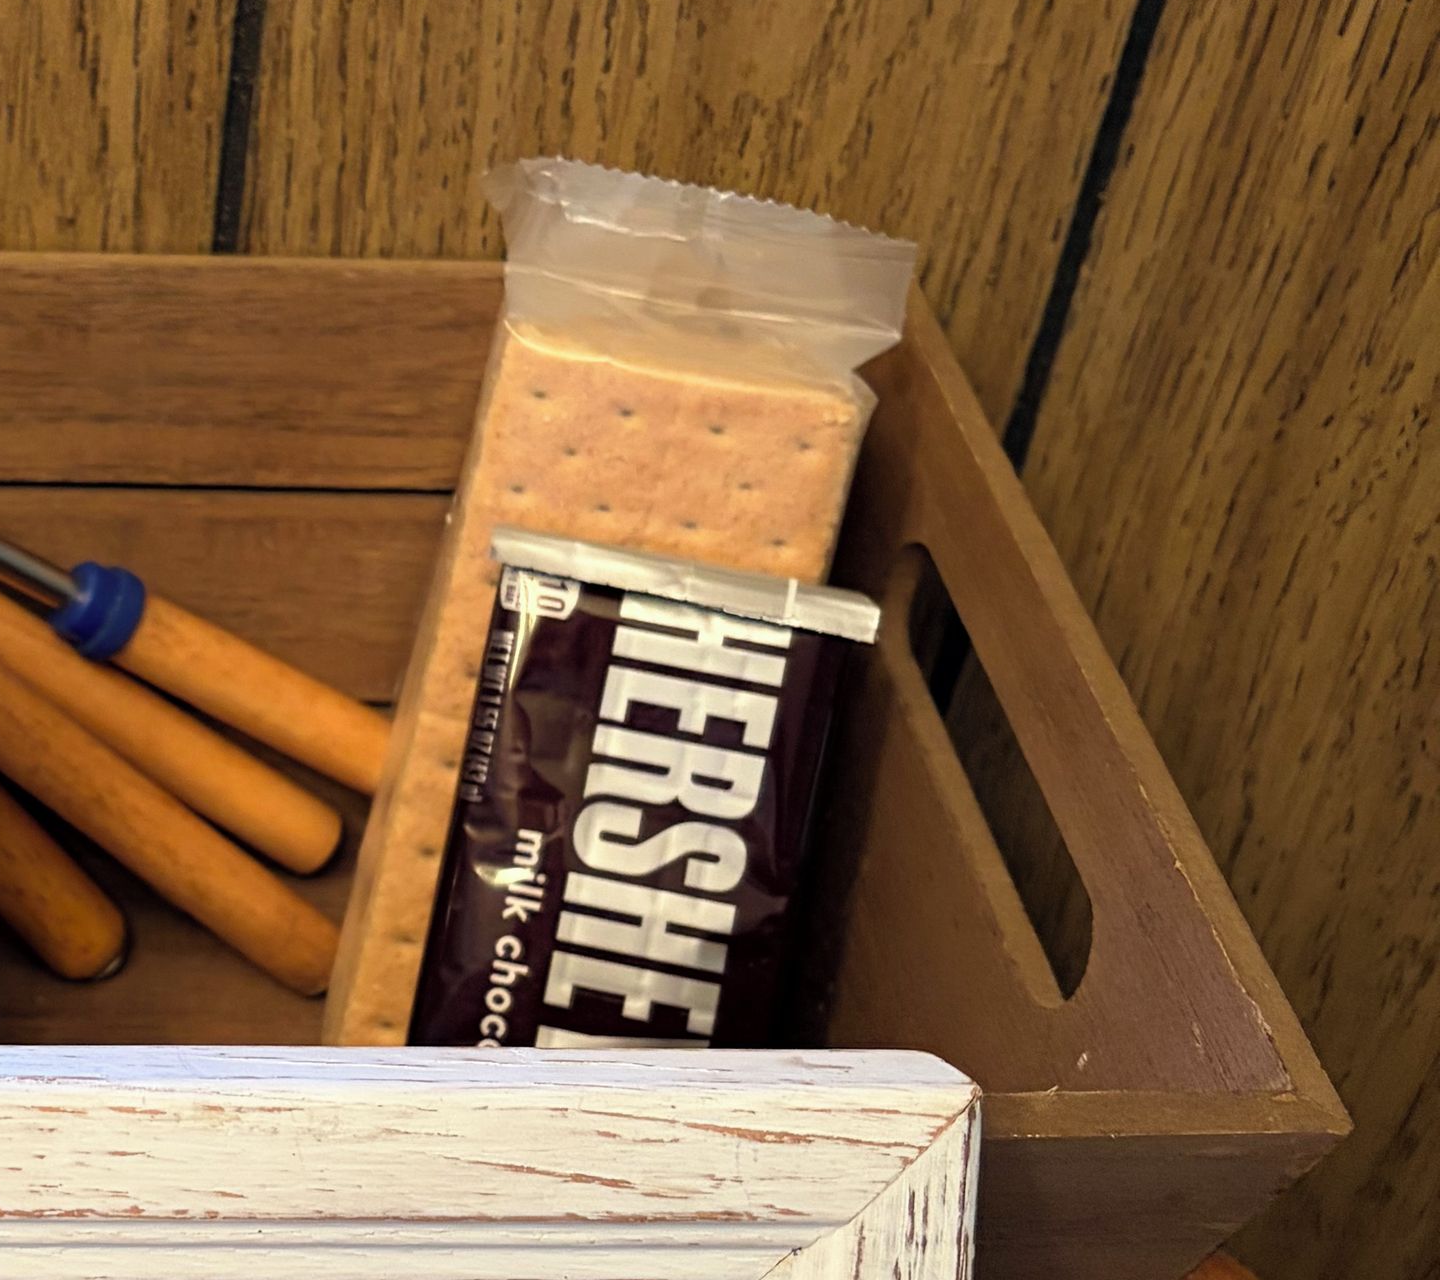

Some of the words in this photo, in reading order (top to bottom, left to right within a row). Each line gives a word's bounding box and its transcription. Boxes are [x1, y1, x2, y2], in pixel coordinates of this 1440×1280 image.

[480, 663, 508, 693] WT
[486, 630, 514, 663] NET
[536, 591, 792, 1048] HERSHE
[502, 828, 548, 922] milk
